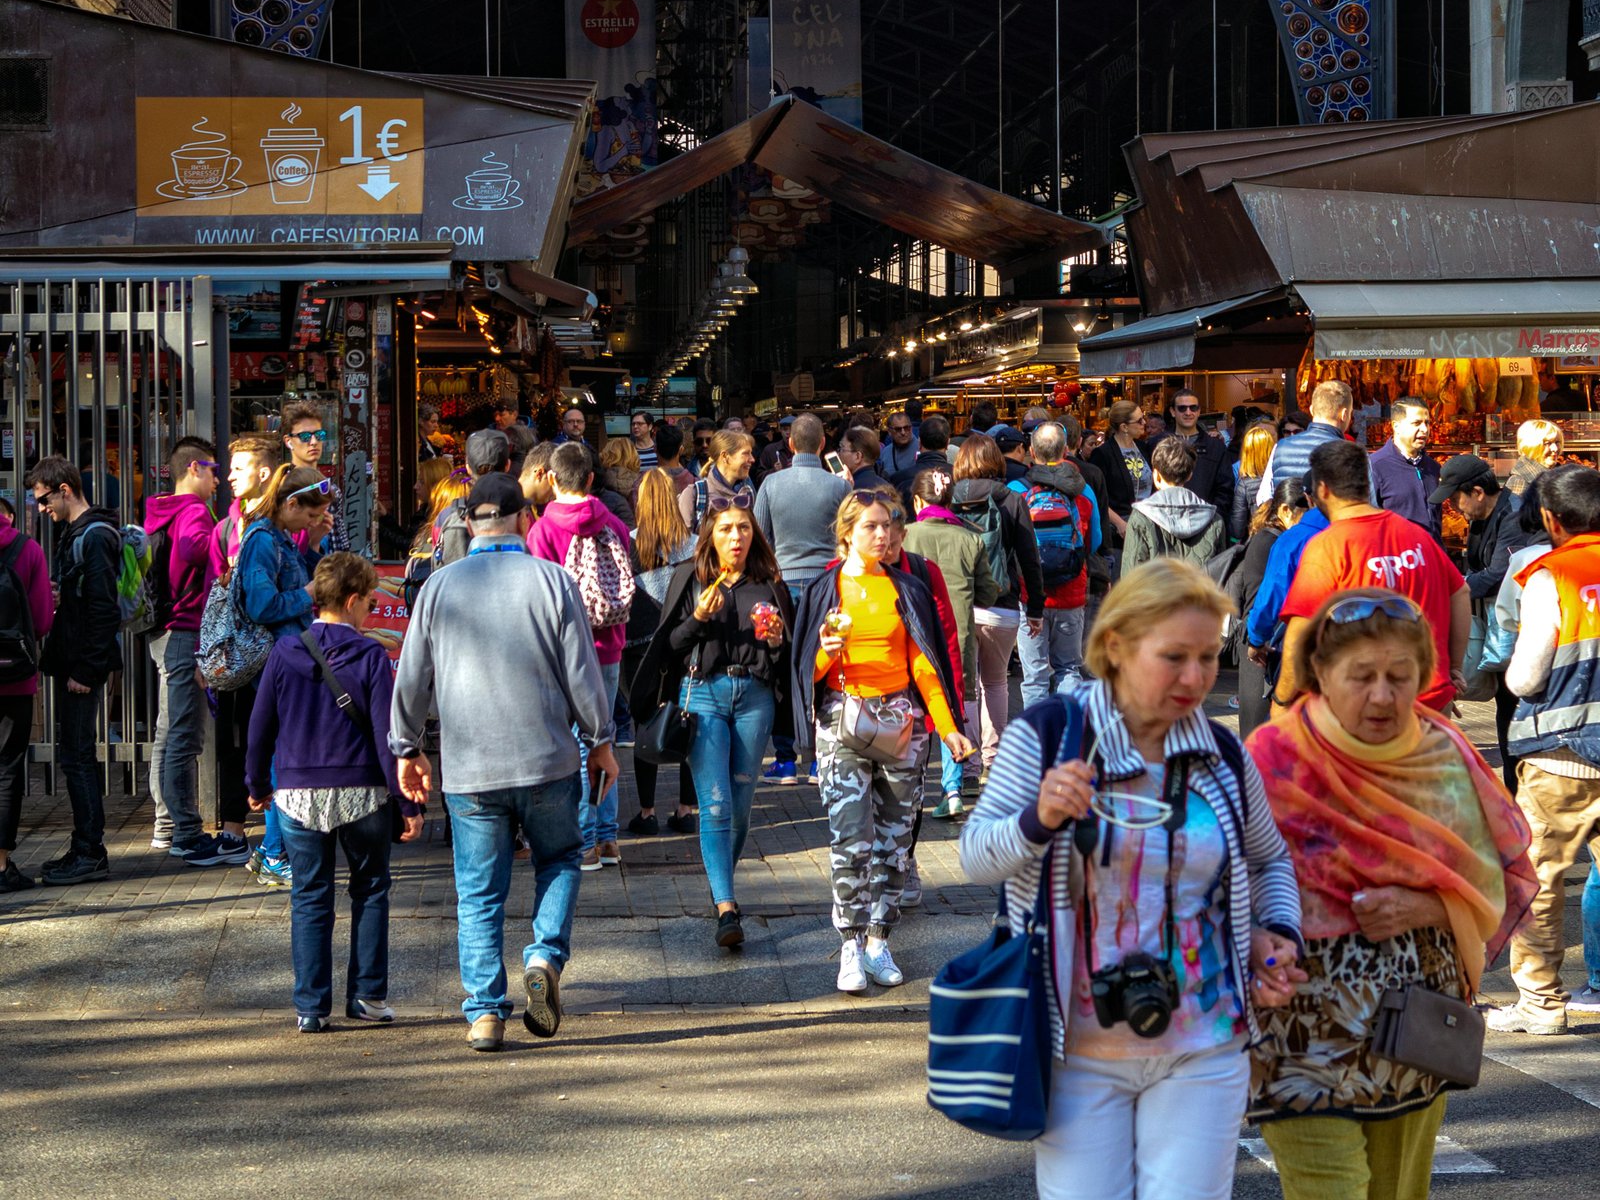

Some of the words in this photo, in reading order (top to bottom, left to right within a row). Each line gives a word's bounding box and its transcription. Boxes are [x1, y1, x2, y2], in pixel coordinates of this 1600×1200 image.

[792, 3, 841, 25] CEL
[585, 18, 635, 28] ESTRELLA
[339, 105, 407, 164] 1€
[184, 169, 219, 177] ESPRESSO
[278, 165, 307, 176] Coffee
[197, 228, 255, 244] WWW
[436, 226, 484, 246] COM
[1518, 328, 1600, 349] Marcos
[1508, 362, 1520, 373] 69
